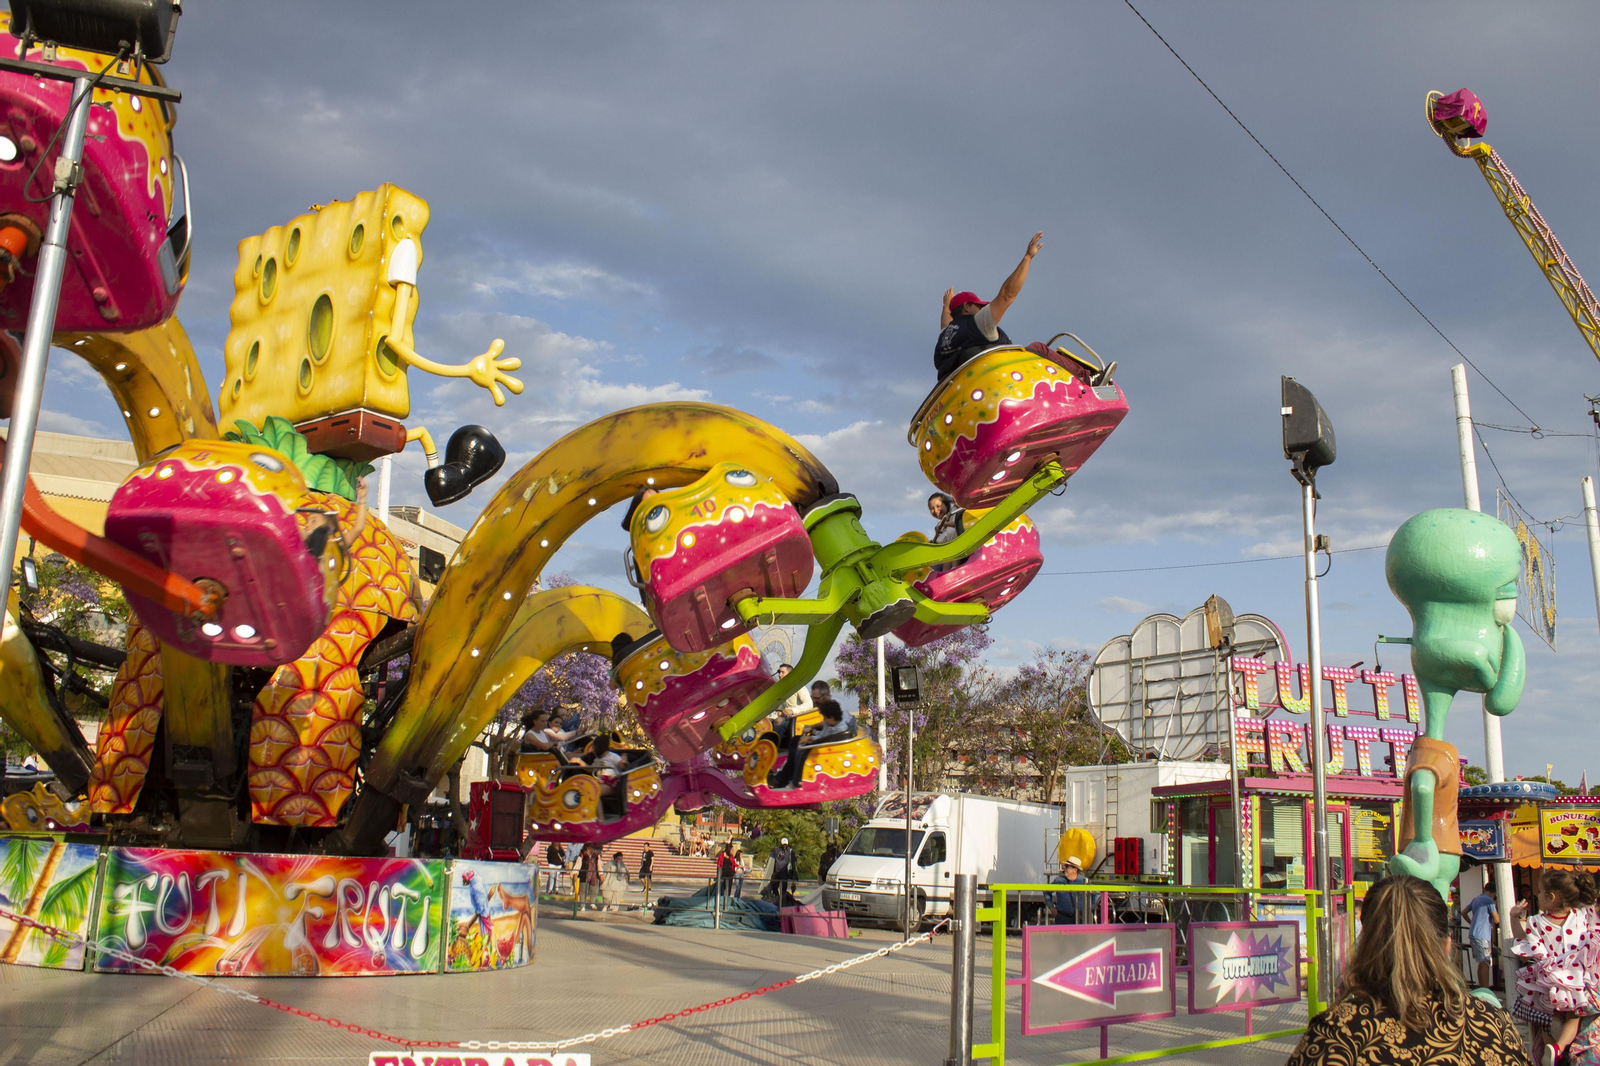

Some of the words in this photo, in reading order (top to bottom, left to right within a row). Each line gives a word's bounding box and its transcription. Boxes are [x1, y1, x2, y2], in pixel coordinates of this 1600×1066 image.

[691, 499, 716, 518] 10
[1233, 656, 1421, 724] TUTTI
[1235, 716, 1424, 779] FRUTT
[114, 868, 247, 950] TUTI
[284, 875, 431, 958] FRUTI
[1084, 961, 1157, 987] ENTRADA
[1223, 953, 1279, 980] TUTTI-FRUTTI
